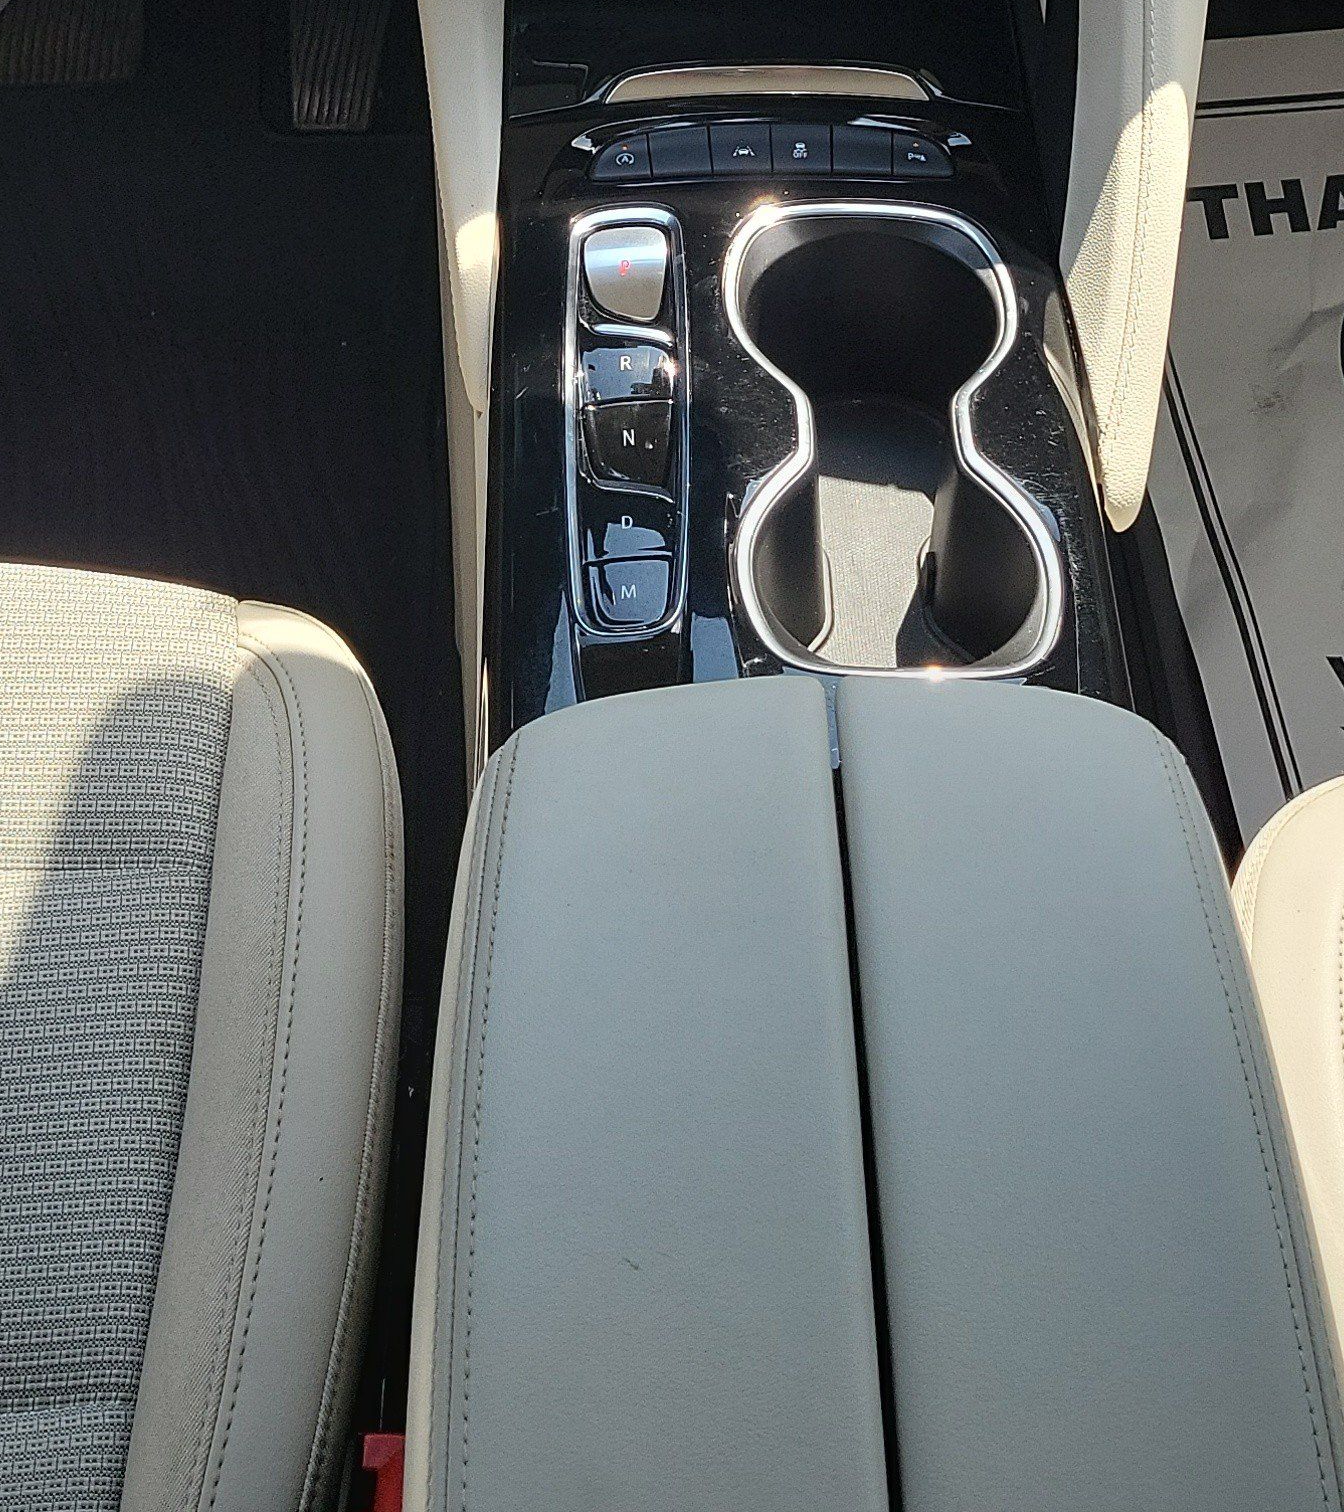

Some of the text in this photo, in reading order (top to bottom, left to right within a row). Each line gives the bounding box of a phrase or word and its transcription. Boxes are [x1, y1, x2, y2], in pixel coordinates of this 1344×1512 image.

[792, 150, 807, 160] OFF
[619, 355, 632, 372] R
[622, 429, 635, 446] N
[620, 514, 634, 530] D
[620, 584, 638, 600] M
